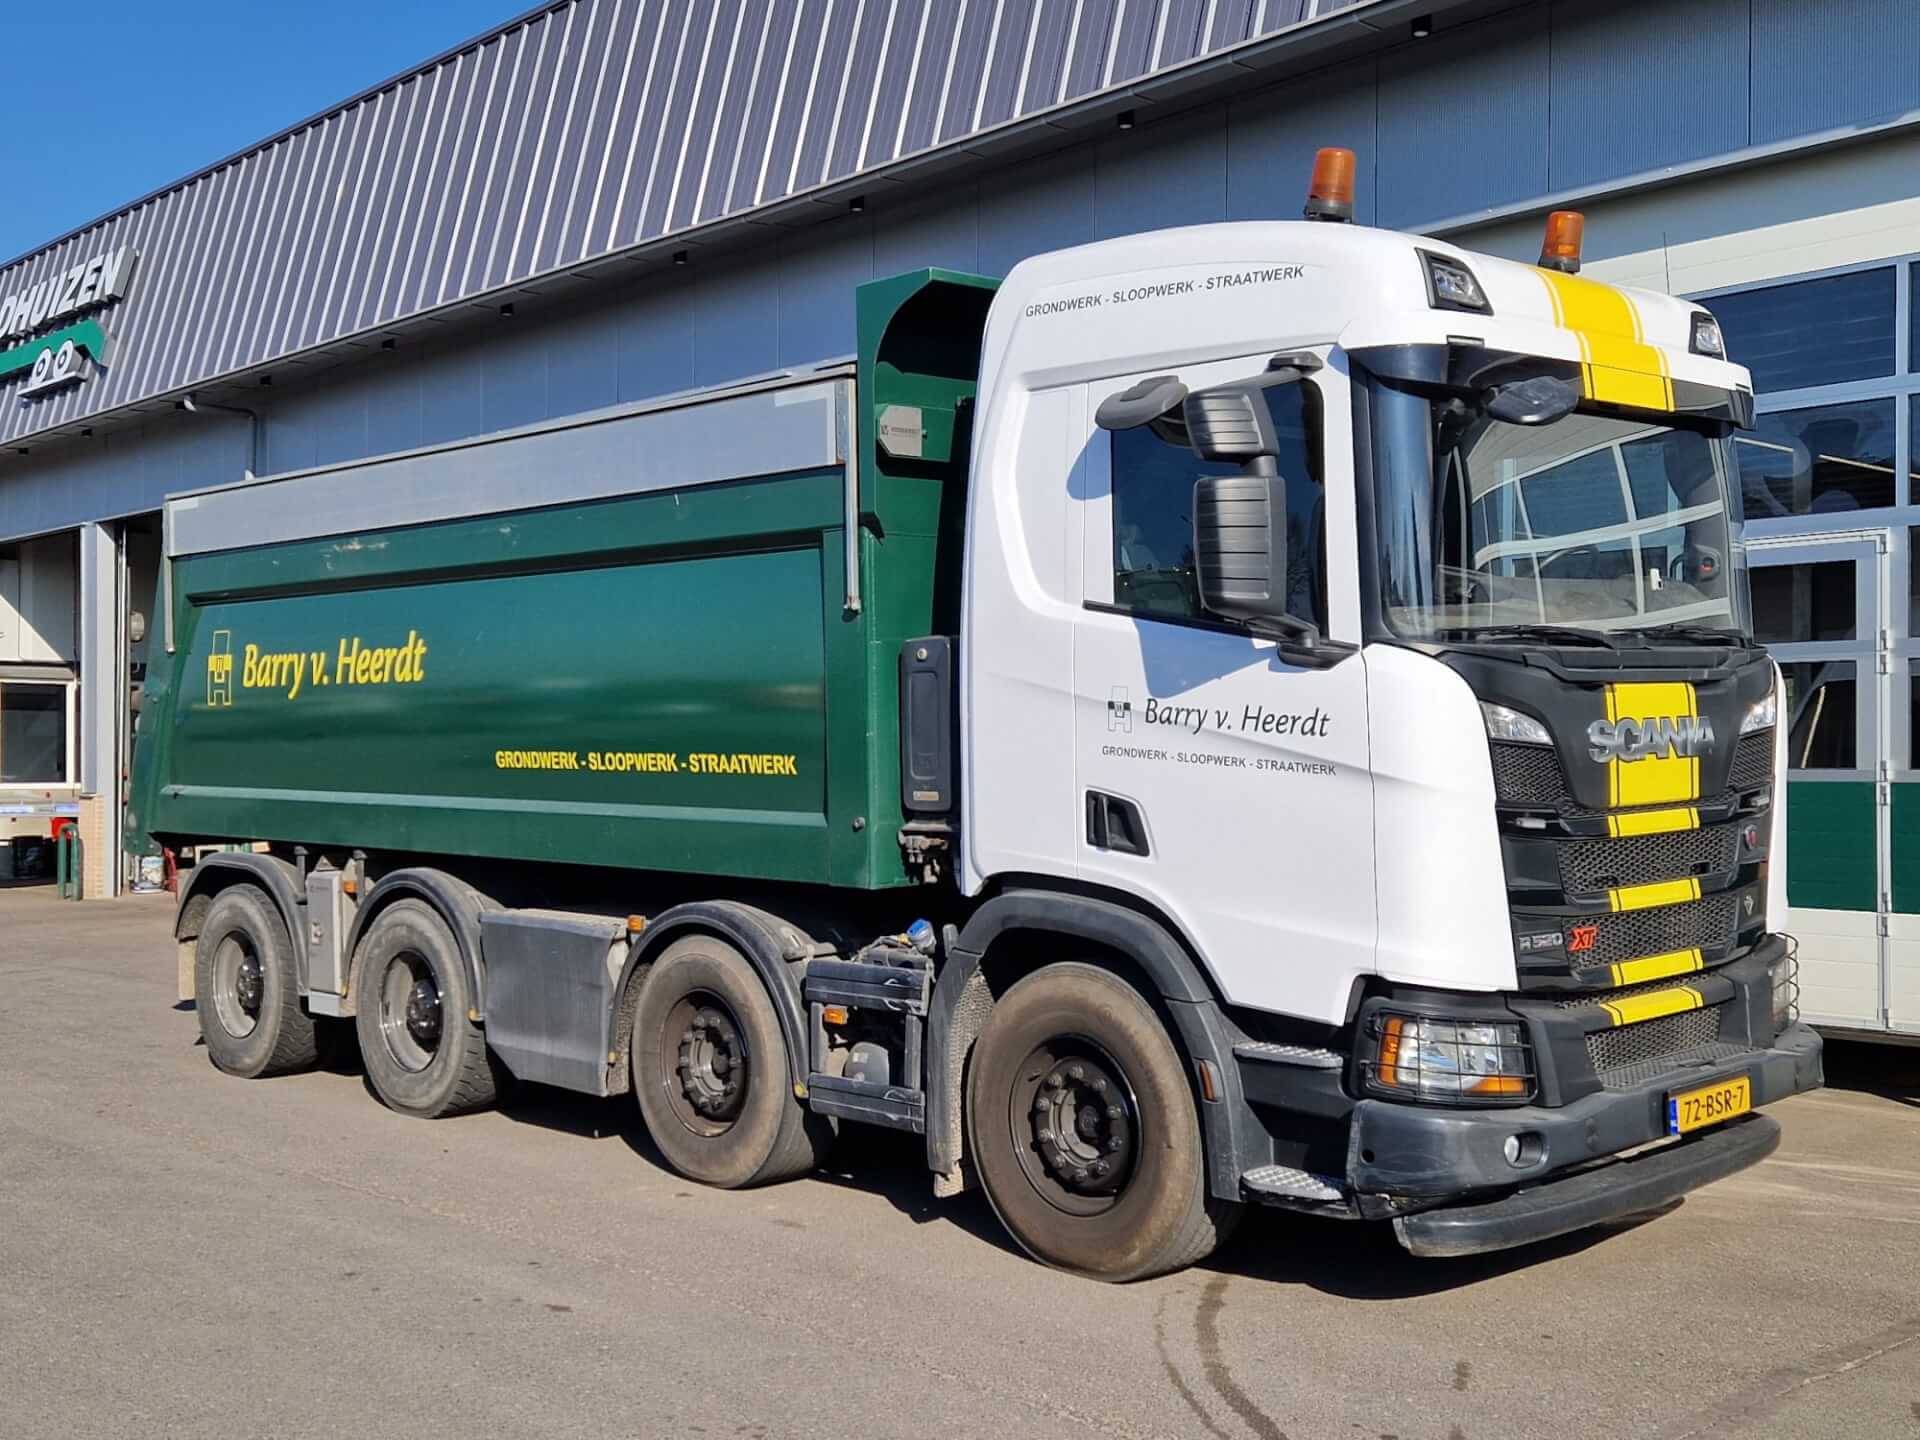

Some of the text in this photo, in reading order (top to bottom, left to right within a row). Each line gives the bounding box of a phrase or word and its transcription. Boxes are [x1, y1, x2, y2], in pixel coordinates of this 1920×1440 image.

[1025, 293, 1102, 317] GRONDWERK
[1112, 280, 1194, 304] SLOOPWERK
[1206, 265, 1304, 290] STRAATWERK
[242, 629, 428, 701] Barry v. Heerdt
[1145, 698, 1331, 737] Barry v. Heerdt
[1587, 716, 1716, 763] SCANIA
[495, 751, 579, 770] GRONDWERK
[588, 752, 678, 772] SLOOPWERK
[689, 753, 798, 776] STRAATWERK
[1102, 745, 1168, 761] GRONDWERK
[1176, 752, 1247, 769] SLOOPWERK
[1255, 758, 1337, 777] STRAATWERK
[1568, 927, 1598, 952] XT
[1684, 1085, 1744, 1124] 72-BSR-7
